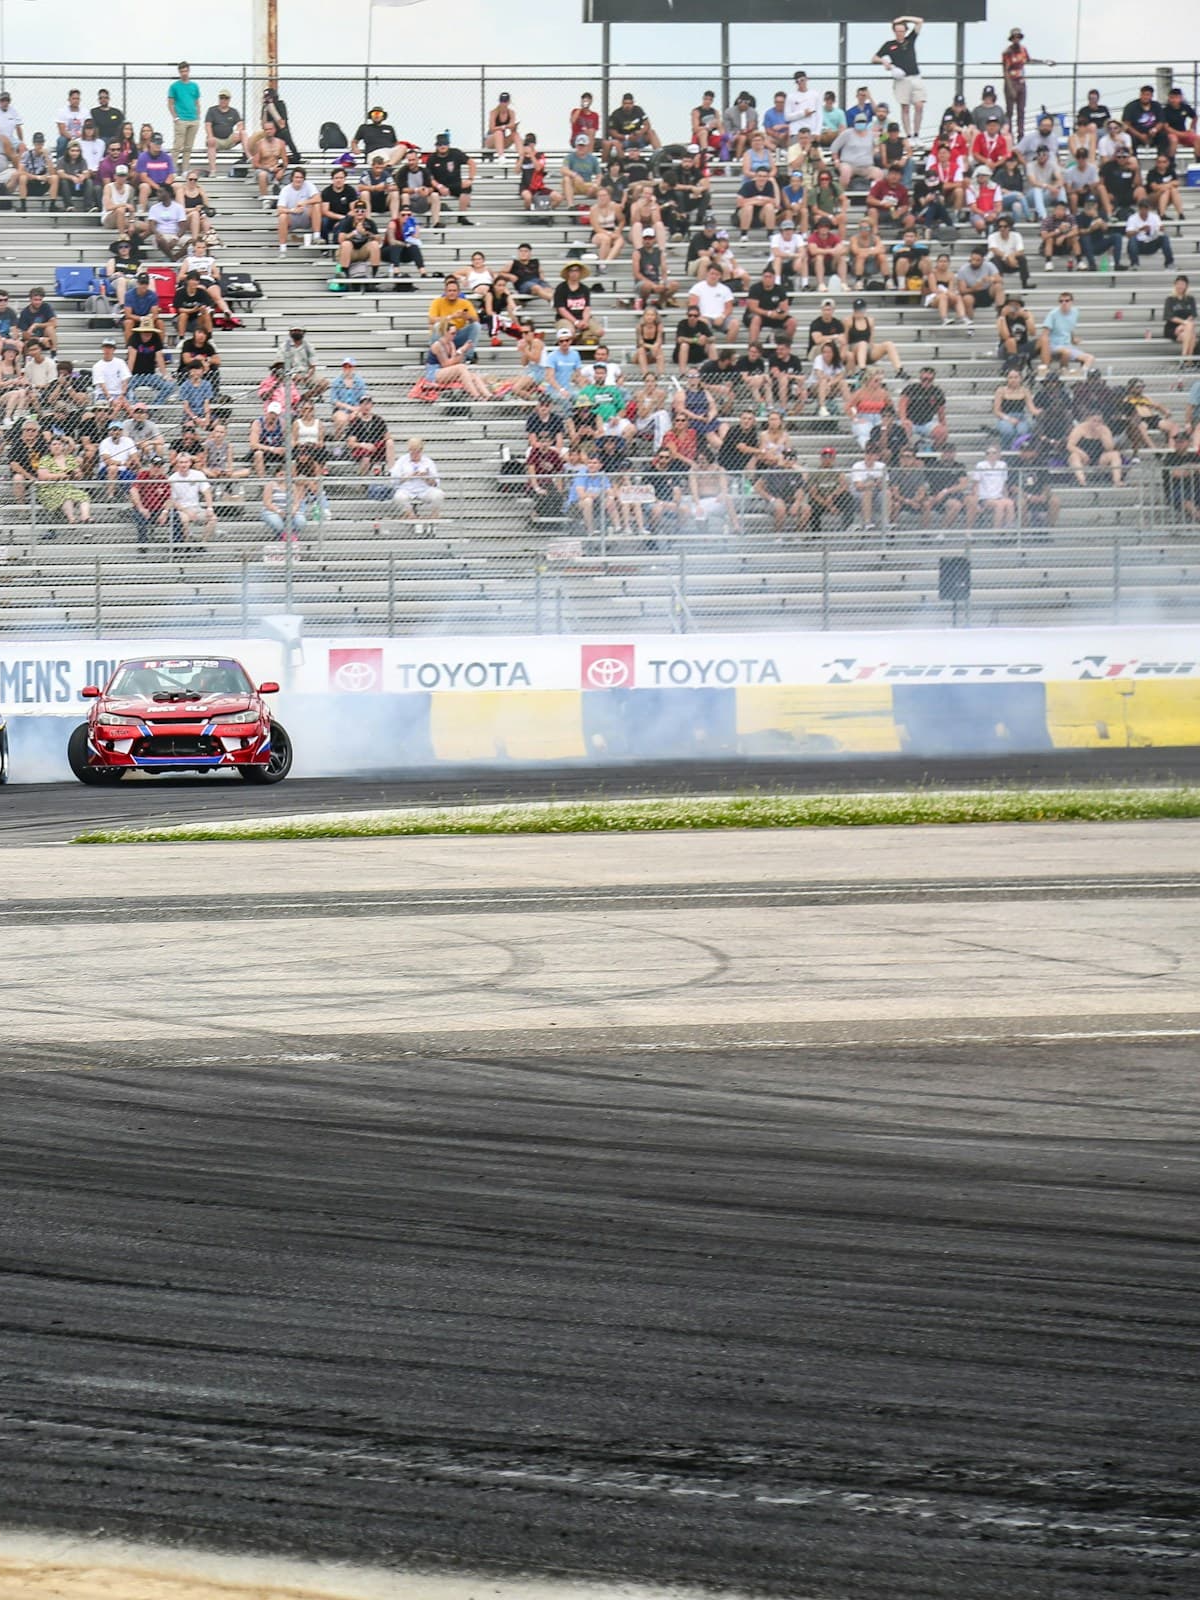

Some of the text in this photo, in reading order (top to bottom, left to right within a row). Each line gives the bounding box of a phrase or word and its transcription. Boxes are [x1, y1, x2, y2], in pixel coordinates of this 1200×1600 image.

[0, 660, 71, 704] MEN'S
[397, 661, 532, 688] TOYOTA
[648, 659, 782, 684] TOYOTA
[885, 664, 1044, 677] NITTO
